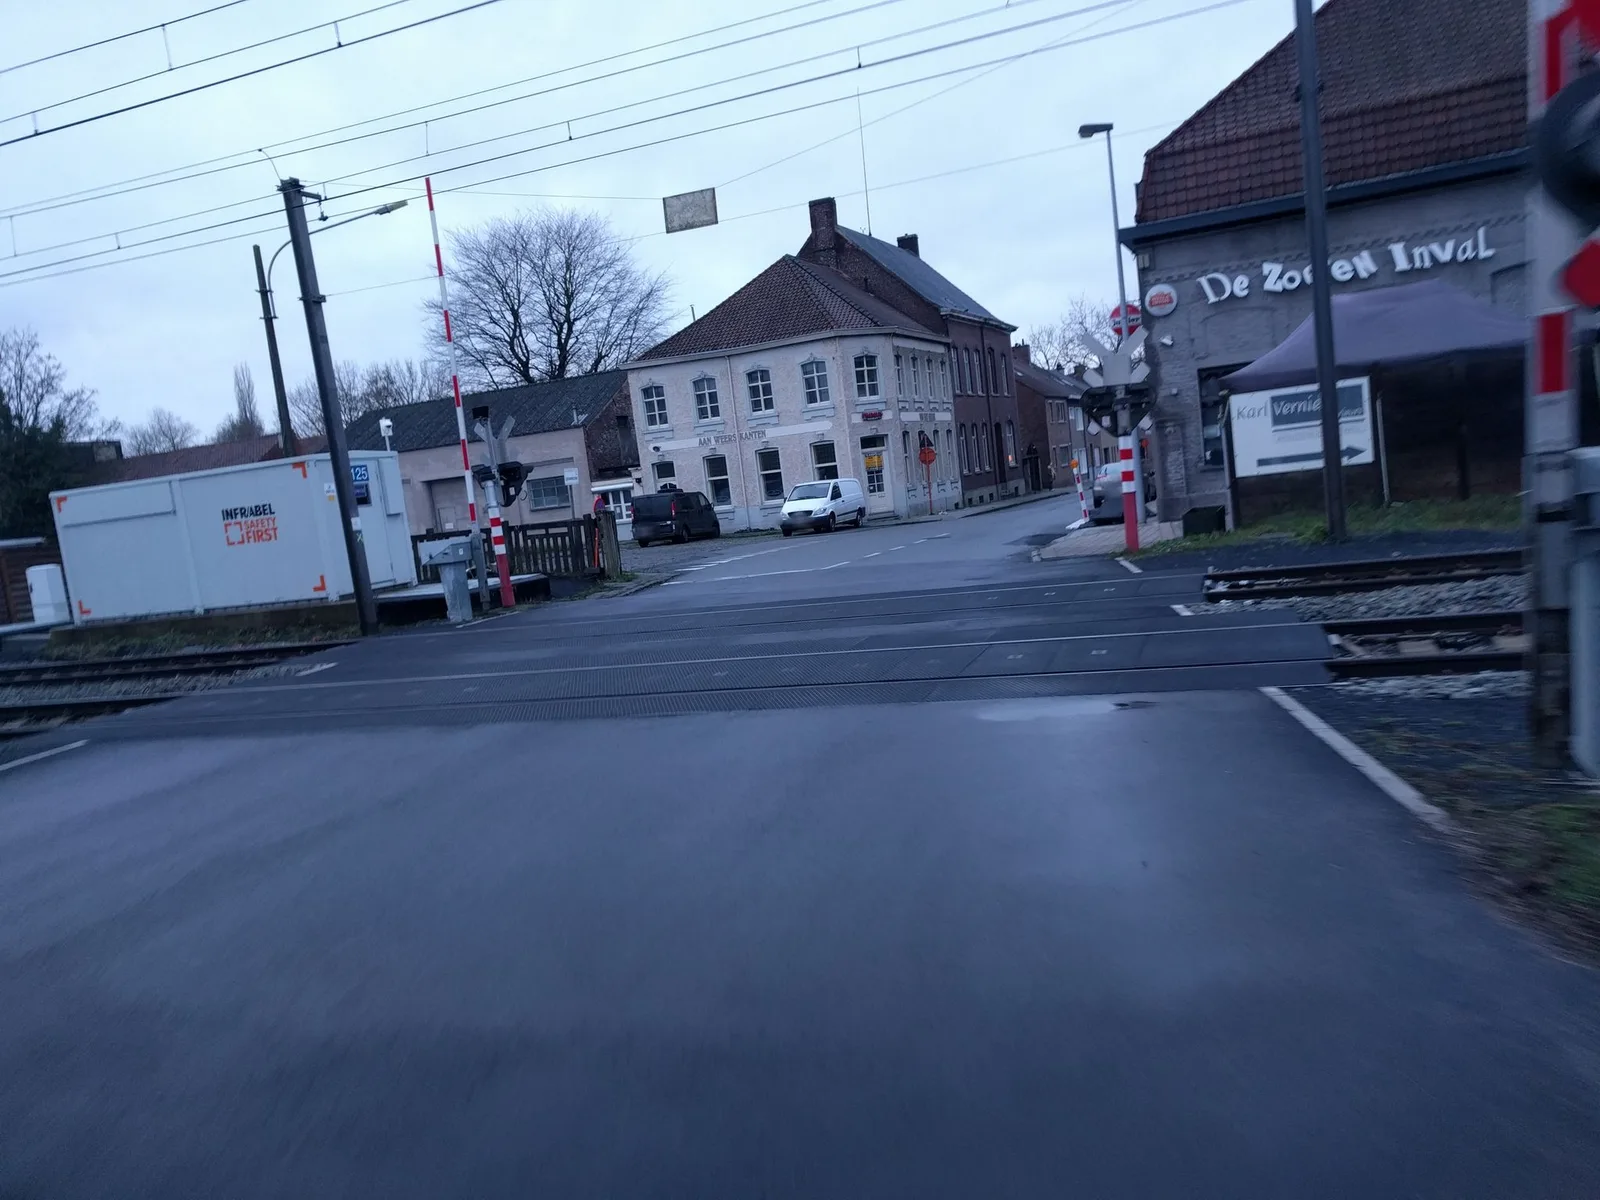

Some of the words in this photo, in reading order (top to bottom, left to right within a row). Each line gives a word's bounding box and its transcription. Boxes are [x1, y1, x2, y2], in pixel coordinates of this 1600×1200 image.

[1196, 272, 1249, 304] De
[1236, 399, 1269, 420] Karl
[698, 436, 712, 446] AAN
[221, 503, 276, 521] INFRABEL
[244, 517, 276, 530] SAFETY
[246, 527, 278, 543] FIRST
